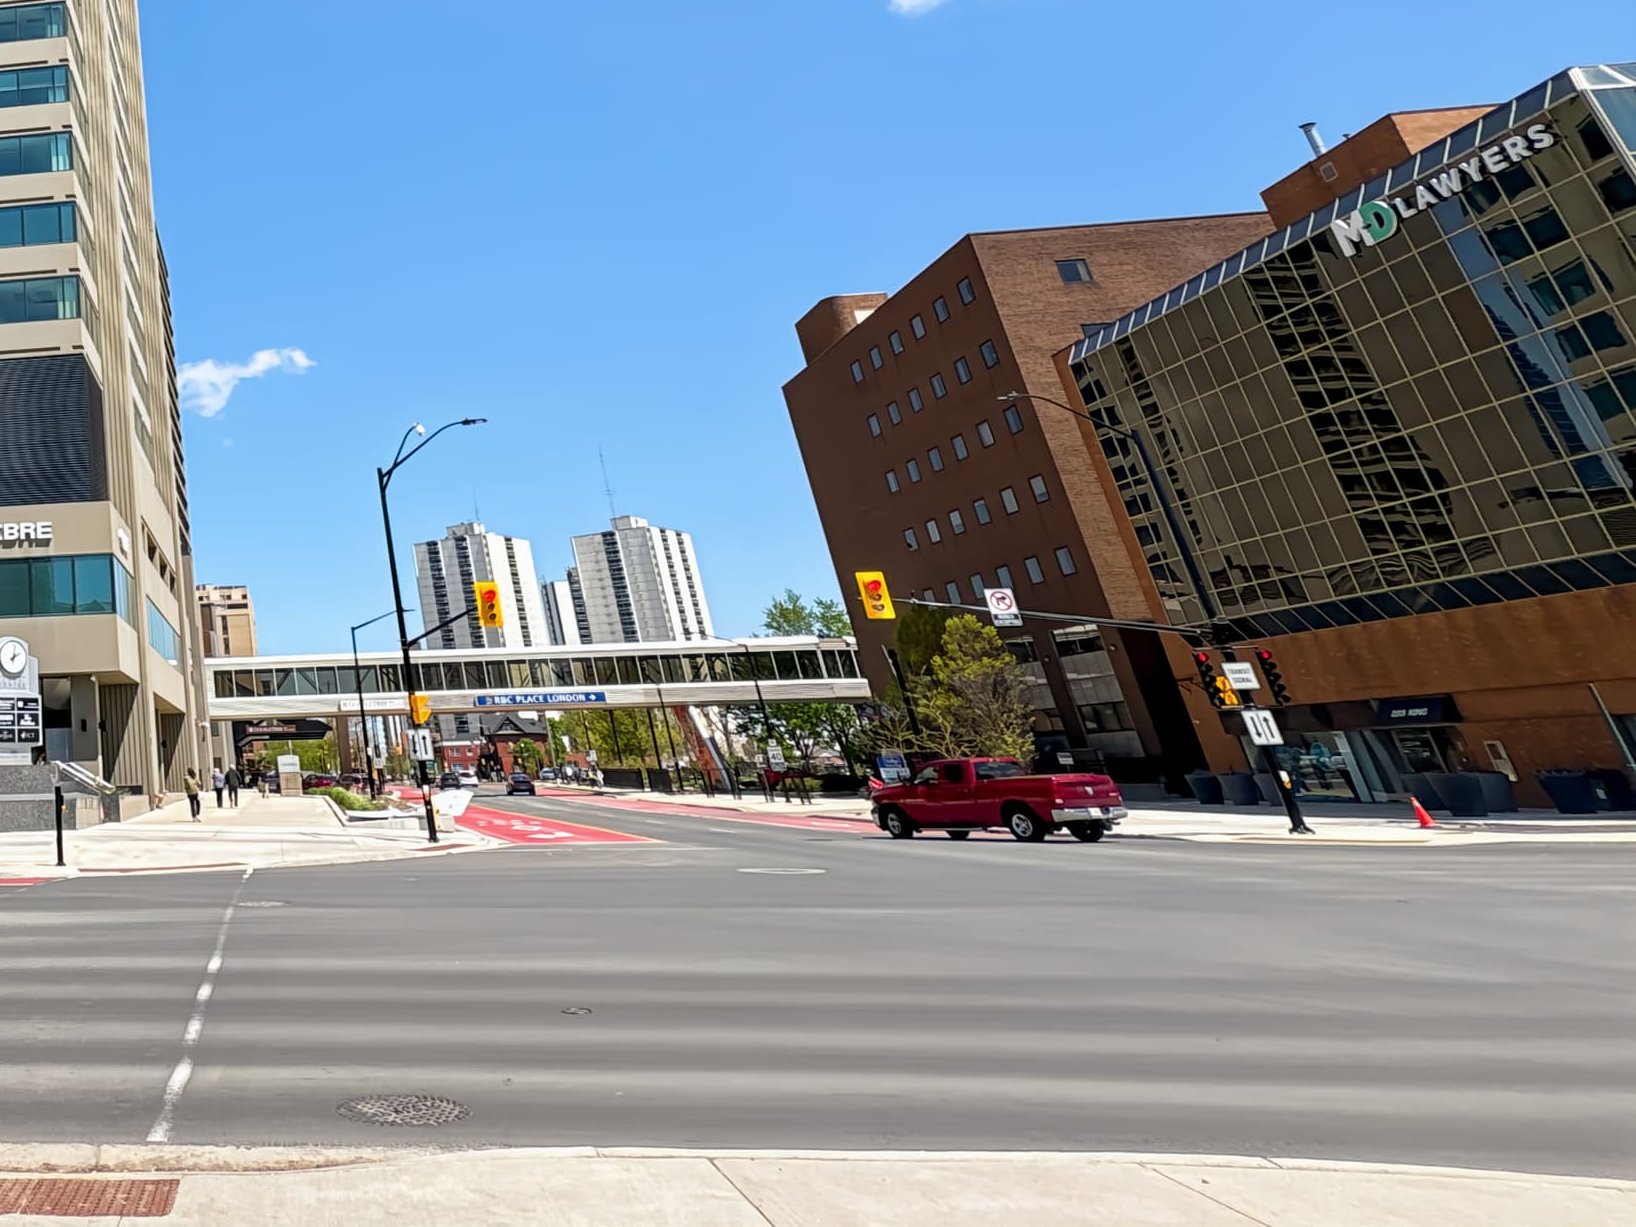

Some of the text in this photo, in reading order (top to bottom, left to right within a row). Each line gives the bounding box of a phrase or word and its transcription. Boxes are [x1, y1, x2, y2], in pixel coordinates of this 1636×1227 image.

[1330, 124, 1555, 257] MD LAWYERS
[494, 693, 586, 704] RBC PLACE LONDON
